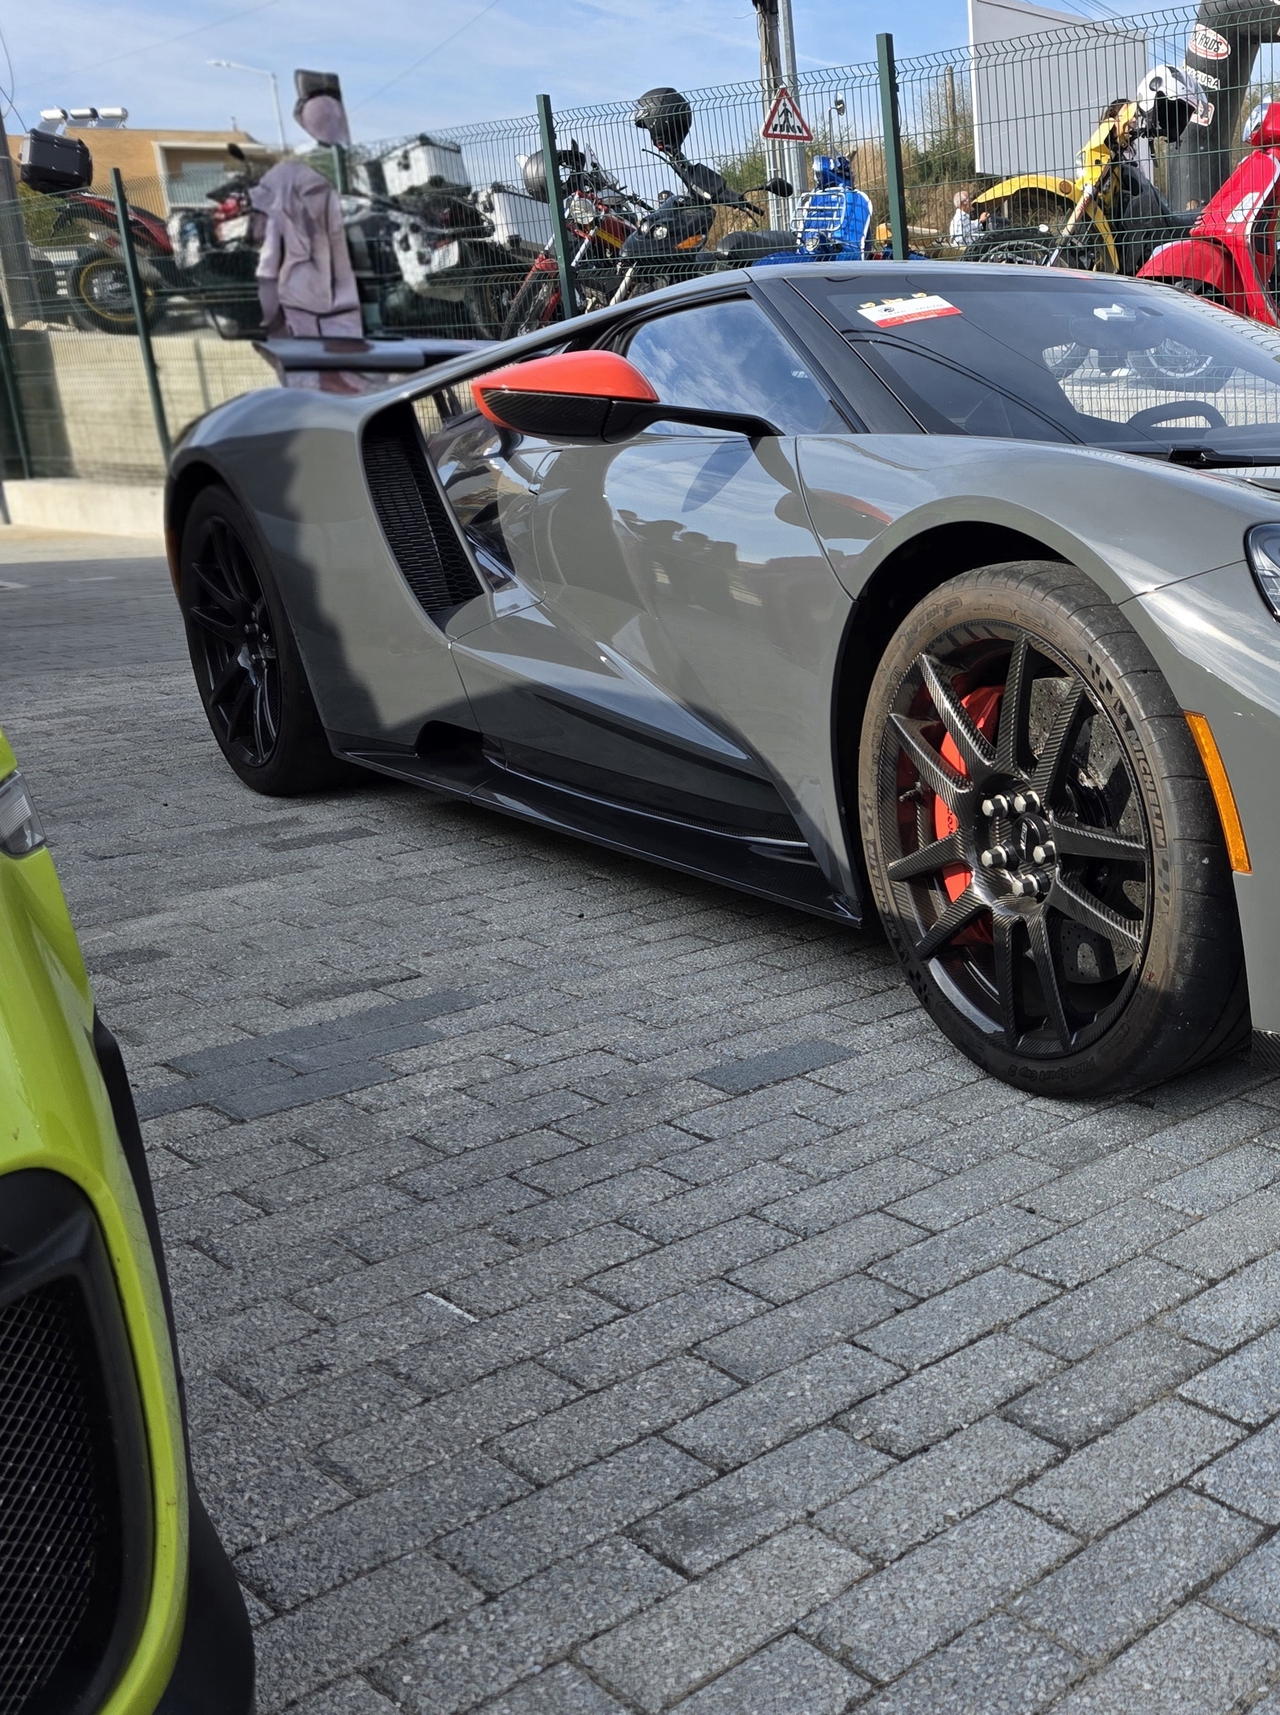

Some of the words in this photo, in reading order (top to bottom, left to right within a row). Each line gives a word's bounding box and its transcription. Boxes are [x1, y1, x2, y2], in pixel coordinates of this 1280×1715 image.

[1127, 729, 1168, 849] MICHELIN
[867, 841, 898, 938] MICHELIN
[1008, 1064, 1018, 1077] 2
[1018, 1066, 1038, 1081] Cup
[1040, 1067, 1069, 1081] Sport
